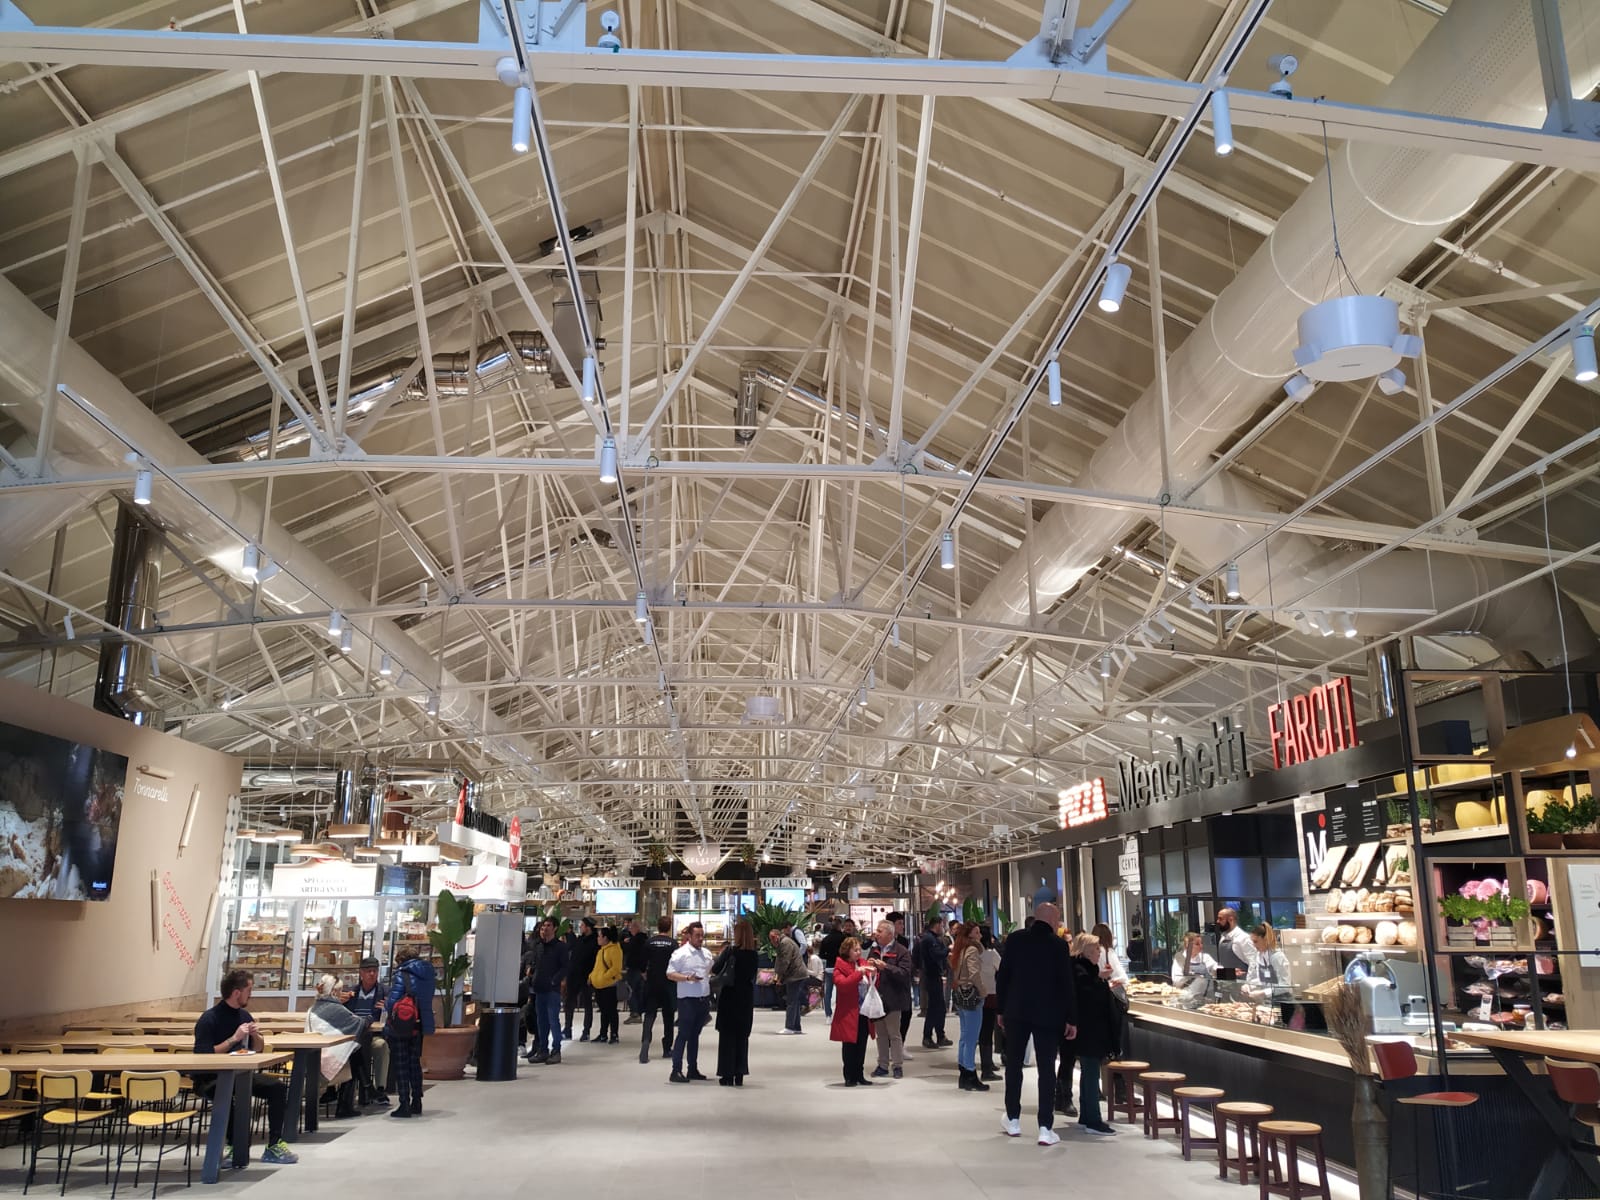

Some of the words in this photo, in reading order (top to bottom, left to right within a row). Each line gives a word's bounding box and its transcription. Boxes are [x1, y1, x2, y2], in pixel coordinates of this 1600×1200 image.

[1267, 676, 1358, 770] FARCITI
[1114, 717, 1253, 813] Menchetti
[685, 856, 716, 864] GELATO
[763, 878, 809, 888] GELATO
